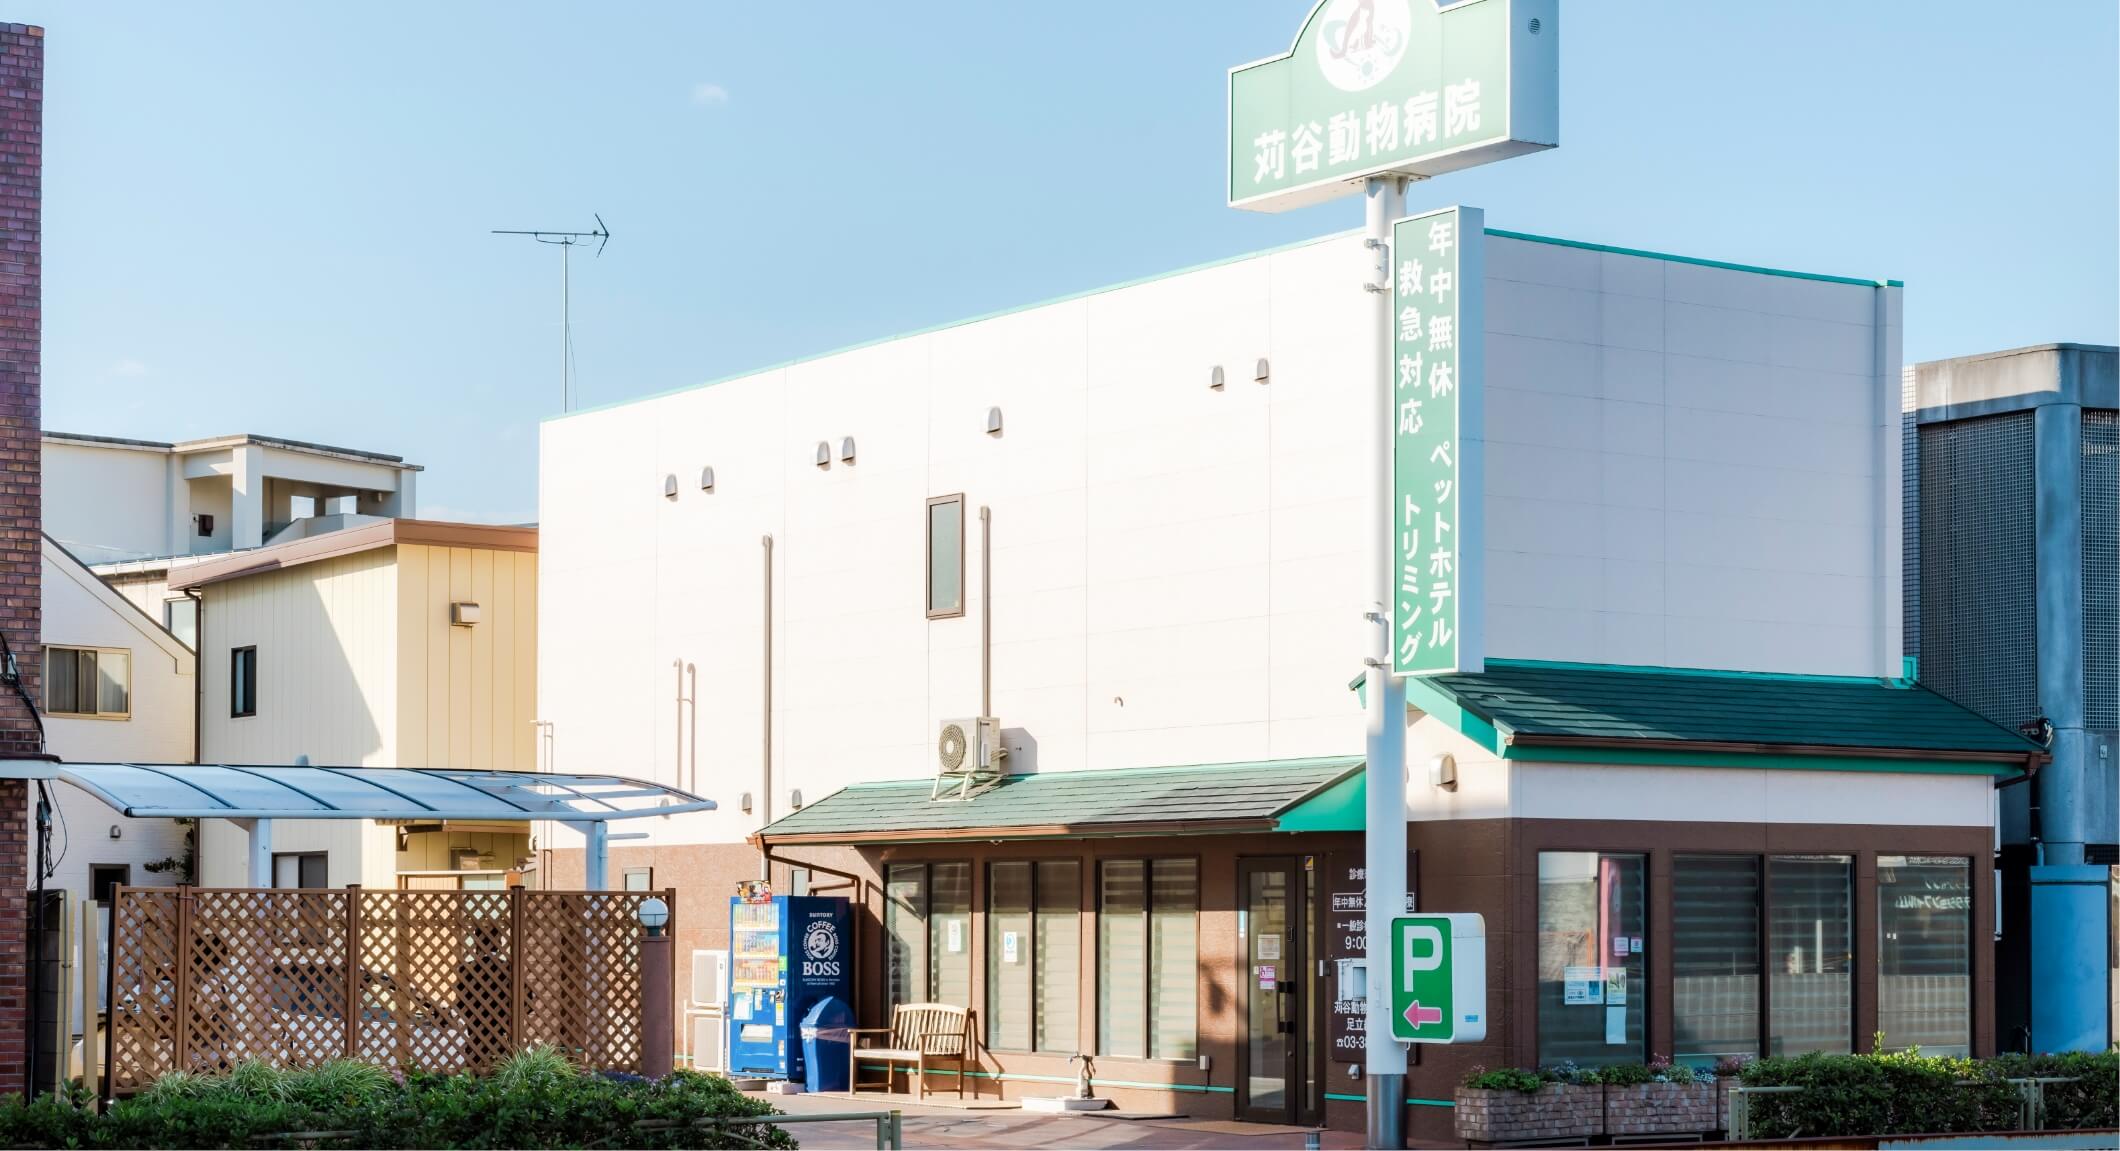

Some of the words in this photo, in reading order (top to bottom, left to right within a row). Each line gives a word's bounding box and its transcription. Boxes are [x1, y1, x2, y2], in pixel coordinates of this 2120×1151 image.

[1253, 77, 1481, 184] 苅谷動物病院
[1428, 221, 1453, 398] 年中無休
[1399, 258, 1423, 436] 救急対応
[1428, 440, 1453, 649] ペットホテル
[1401, 494, 1423, 666] トリミング
[1334, 896, 1366, 908] 年中無休
[1349, 868, 1366, 880] 診療
[807, 921, 836, 933] COFFEE
[1341, 920, 1366, 932] 一般診
[1403, 925, 1443, 992] P
[803, 961, 840, 976] BOSS
